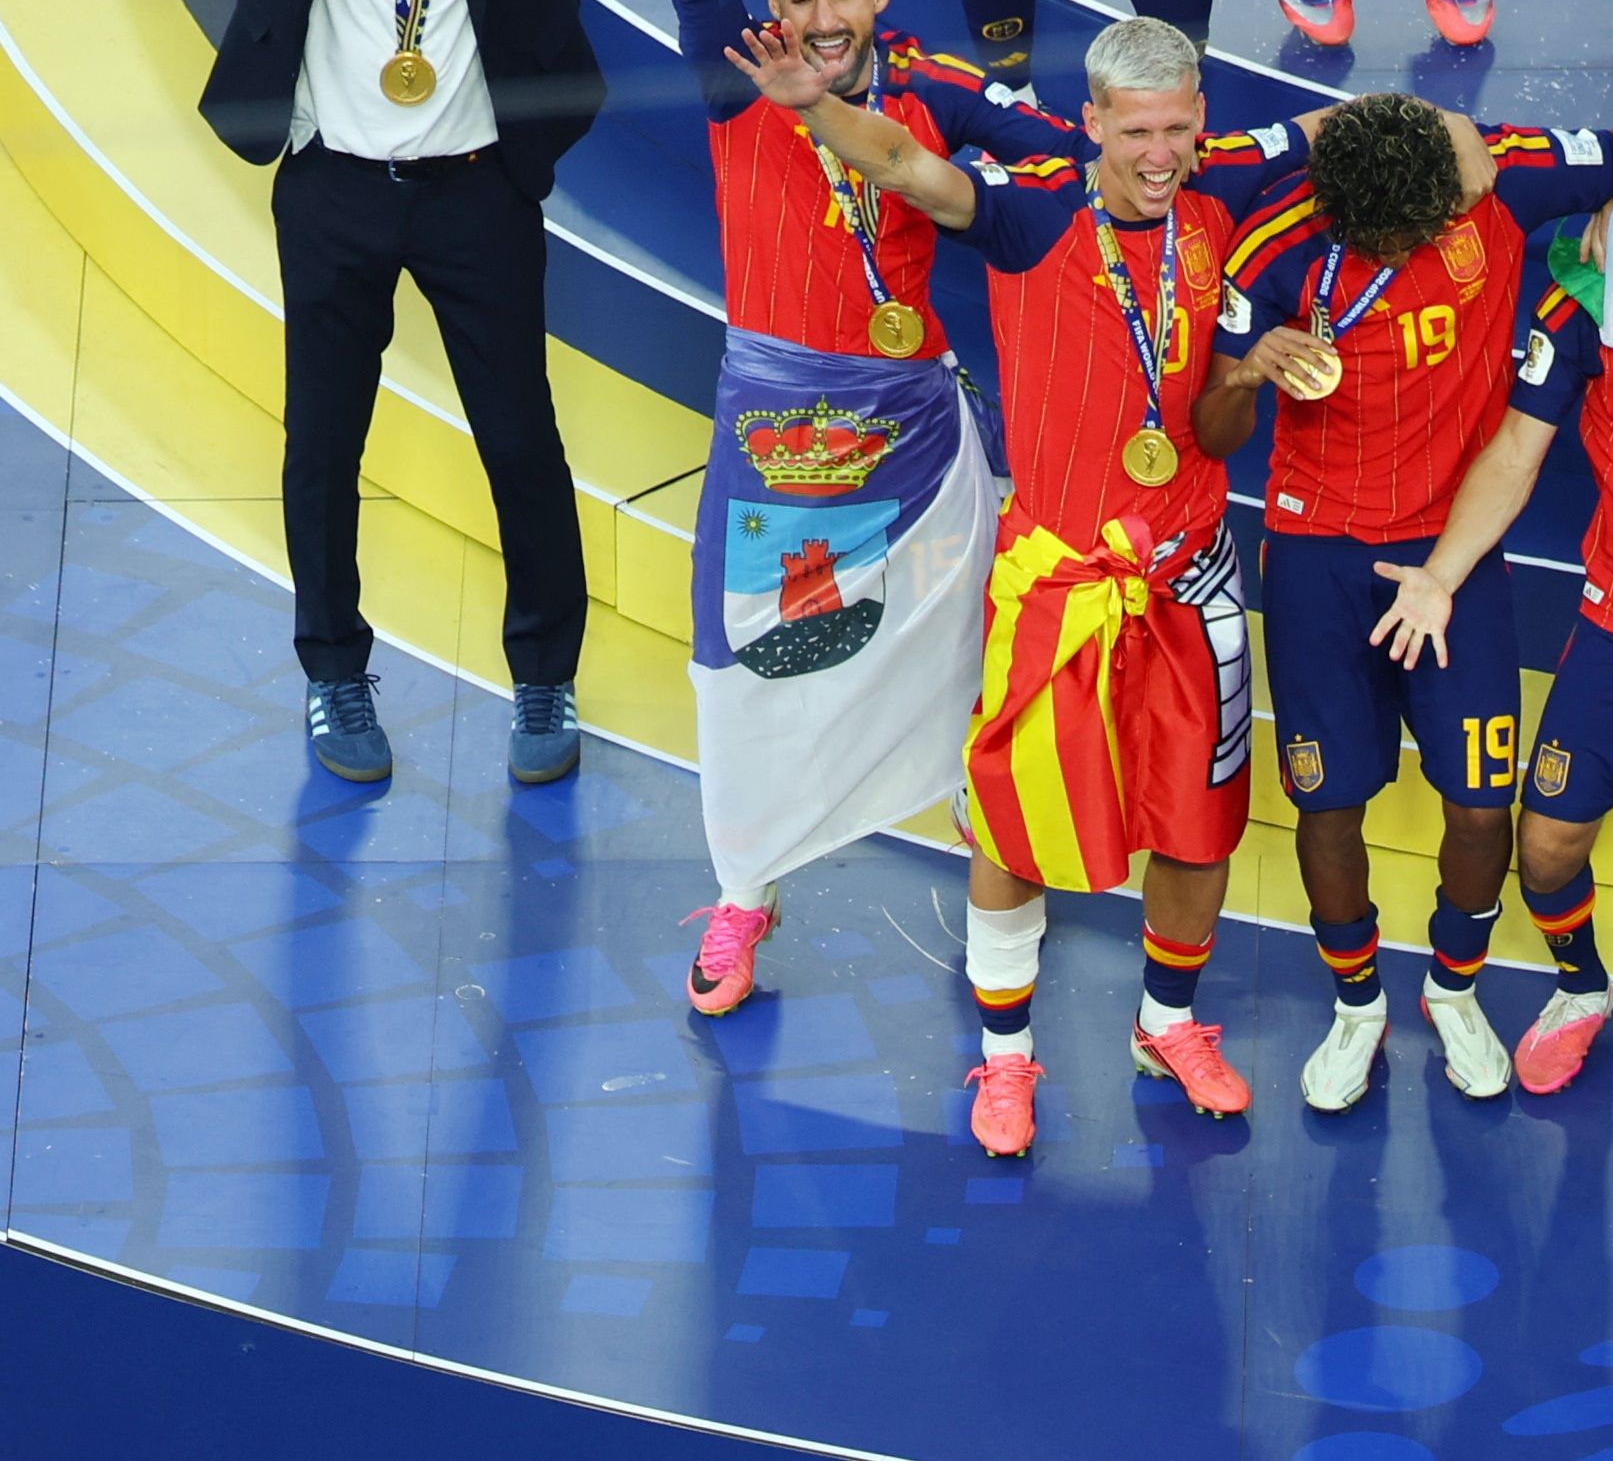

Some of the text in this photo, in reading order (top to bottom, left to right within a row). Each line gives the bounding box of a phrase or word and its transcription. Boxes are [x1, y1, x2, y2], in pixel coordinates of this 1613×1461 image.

[1165, 231, 1174, 256] FIFA
[1327, 252, 1339, 272] CUP
[873, 289, 886, 304] UP
[1319, 269, 1333, 296] 2026
[1337, 267, 1393, 328] FIFA WORLD CUP 202
[1132, 319, 1155, 381] FIFA WORLD
[1397, 304, 1456, 370] 19
[1462, 714, 1515, 789] 19
